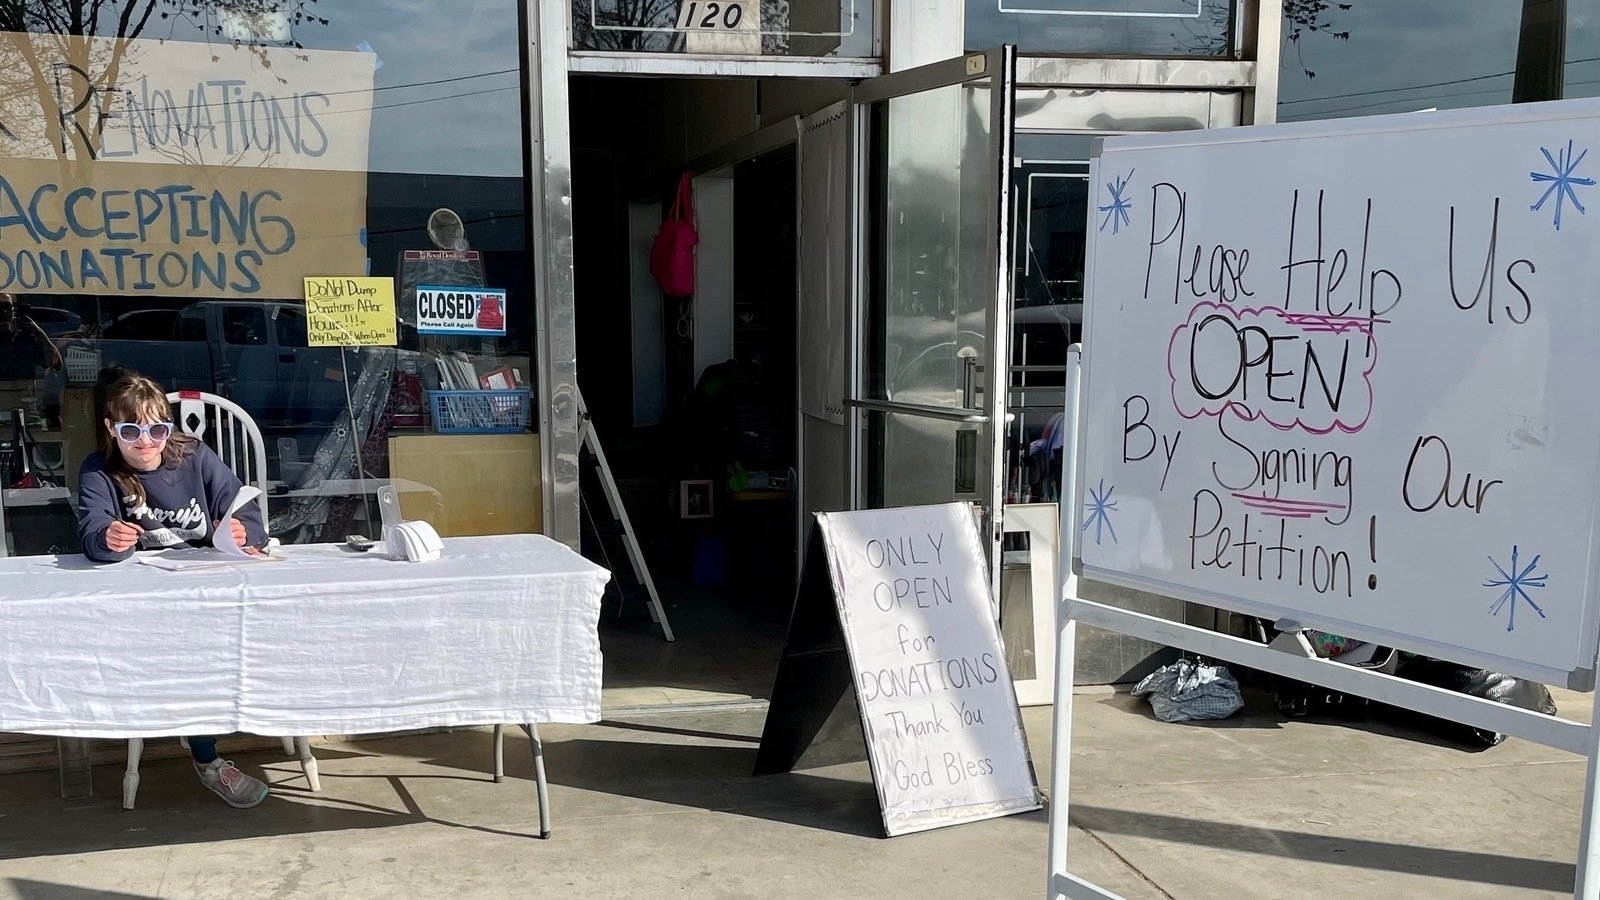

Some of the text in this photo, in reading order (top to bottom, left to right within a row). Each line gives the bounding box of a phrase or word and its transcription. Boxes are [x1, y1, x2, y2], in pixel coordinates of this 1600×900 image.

[685, 2, 742, 28] 120
[0, 175, 295, 255] ACCEPTING
[0, 249, 263, 293] DONATIONS
[347, 280, 376, 296] Dump
[1144, 183, 1536, 358] Please Help Us
[307, 299, 383, 314] Donations After
[419, 292, 474, 319] CLOSED
[309, 332, 325, 344] Only
[1190, 314, 1349, 412] OPEN
[1122, 395, 1504, 525] By Signing Our
[866, 532, 944, 569] ONLY
[1189, 488, 1377, 598] Petition!
[873, 576, 952, 612] OPEN
[860, 652, 998, 702] DONATIONS
[885, 701, 984, 739] Thank You
[894, 752, 994, 791] God Bless
